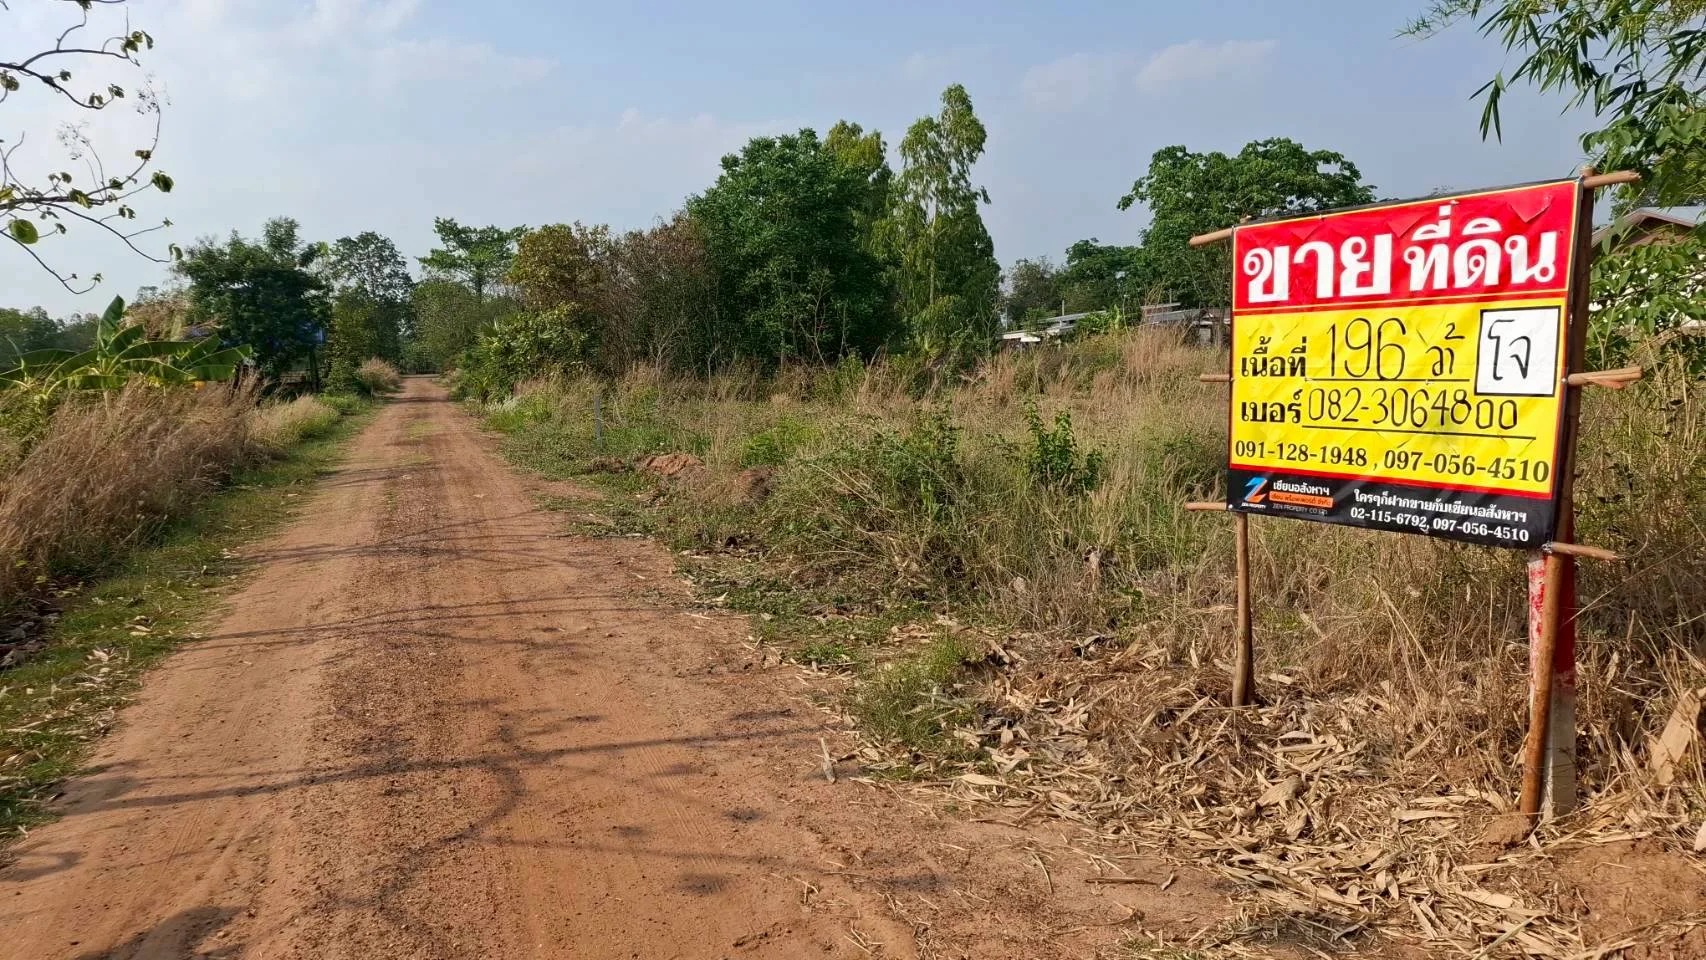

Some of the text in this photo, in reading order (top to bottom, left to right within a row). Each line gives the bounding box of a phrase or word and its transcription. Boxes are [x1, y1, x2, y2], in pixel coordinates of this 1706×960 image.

[1243, 205, 1557, 303] ขาย ที่ดิน
[1241, 336, 1307, 377] เนื้อที่
[1327, 317, 1406, 381] 196
[1241, 387, 1518, 430] เบอร์ 082-3064800
[1433, 517, 1530, 542] 097-056-4510
